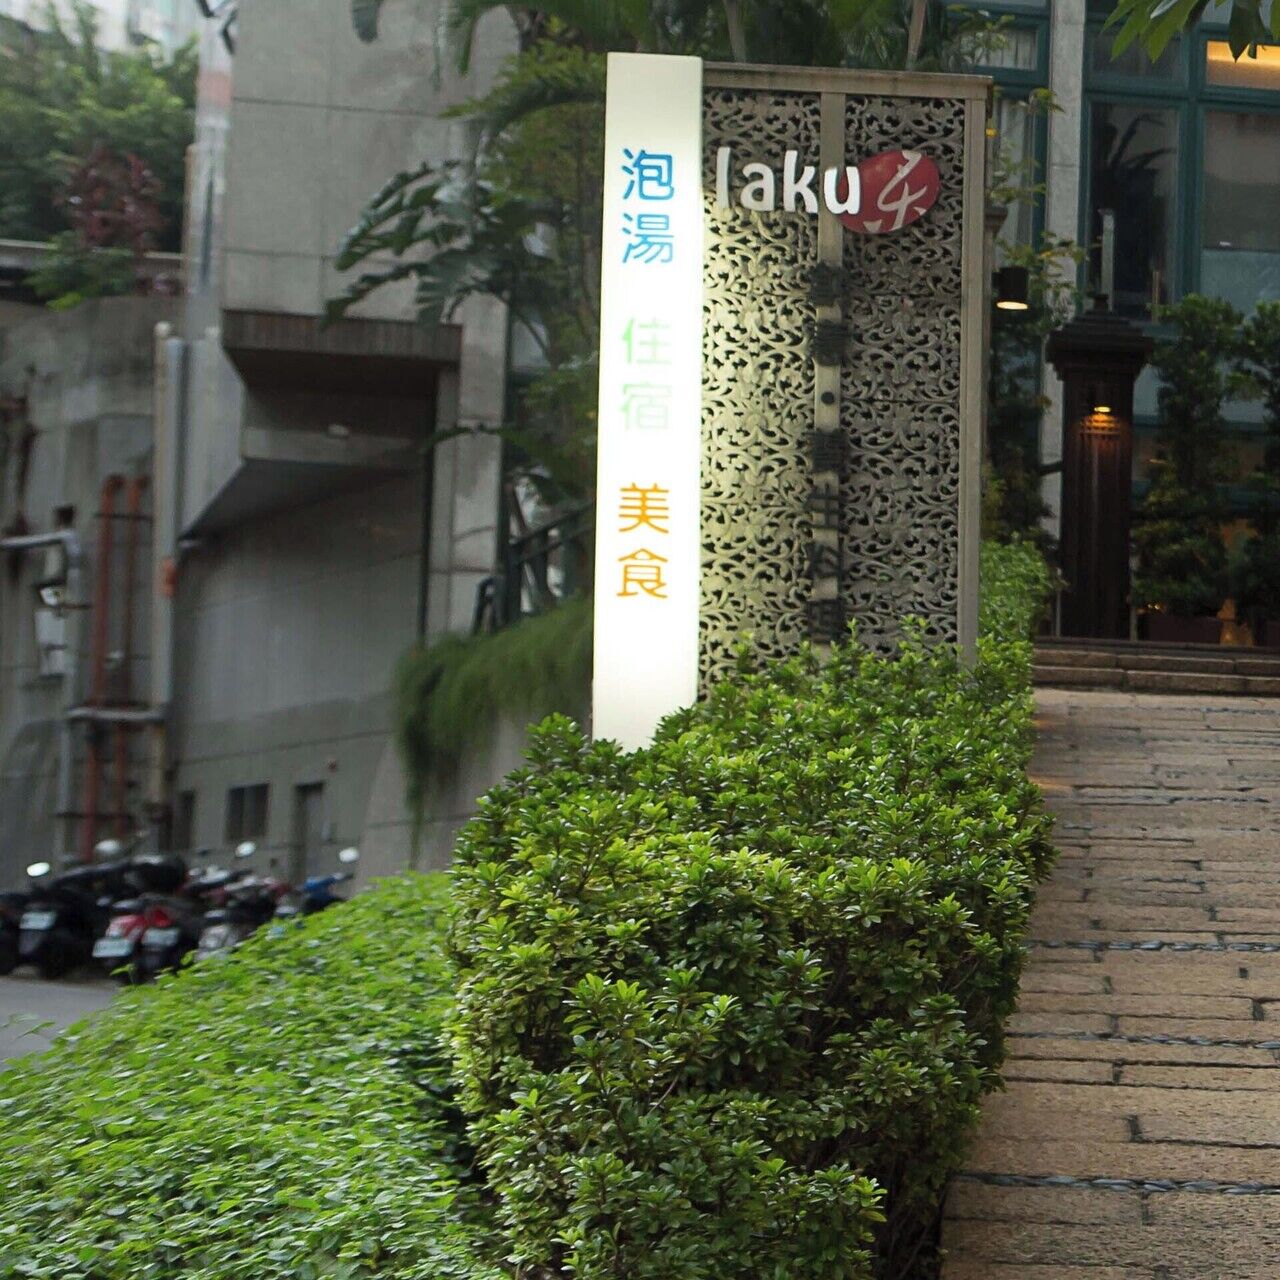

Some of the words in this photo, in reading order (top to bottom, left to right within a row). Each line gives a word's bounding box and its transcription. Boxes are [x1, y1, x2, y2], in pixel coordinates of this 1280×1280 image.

[621, 147, 675, 265] 泡湯
[715, 145, 861, 216] laku
[620, 317, 673, 432] 住宿
[616, 482, 671, 599] 美食
